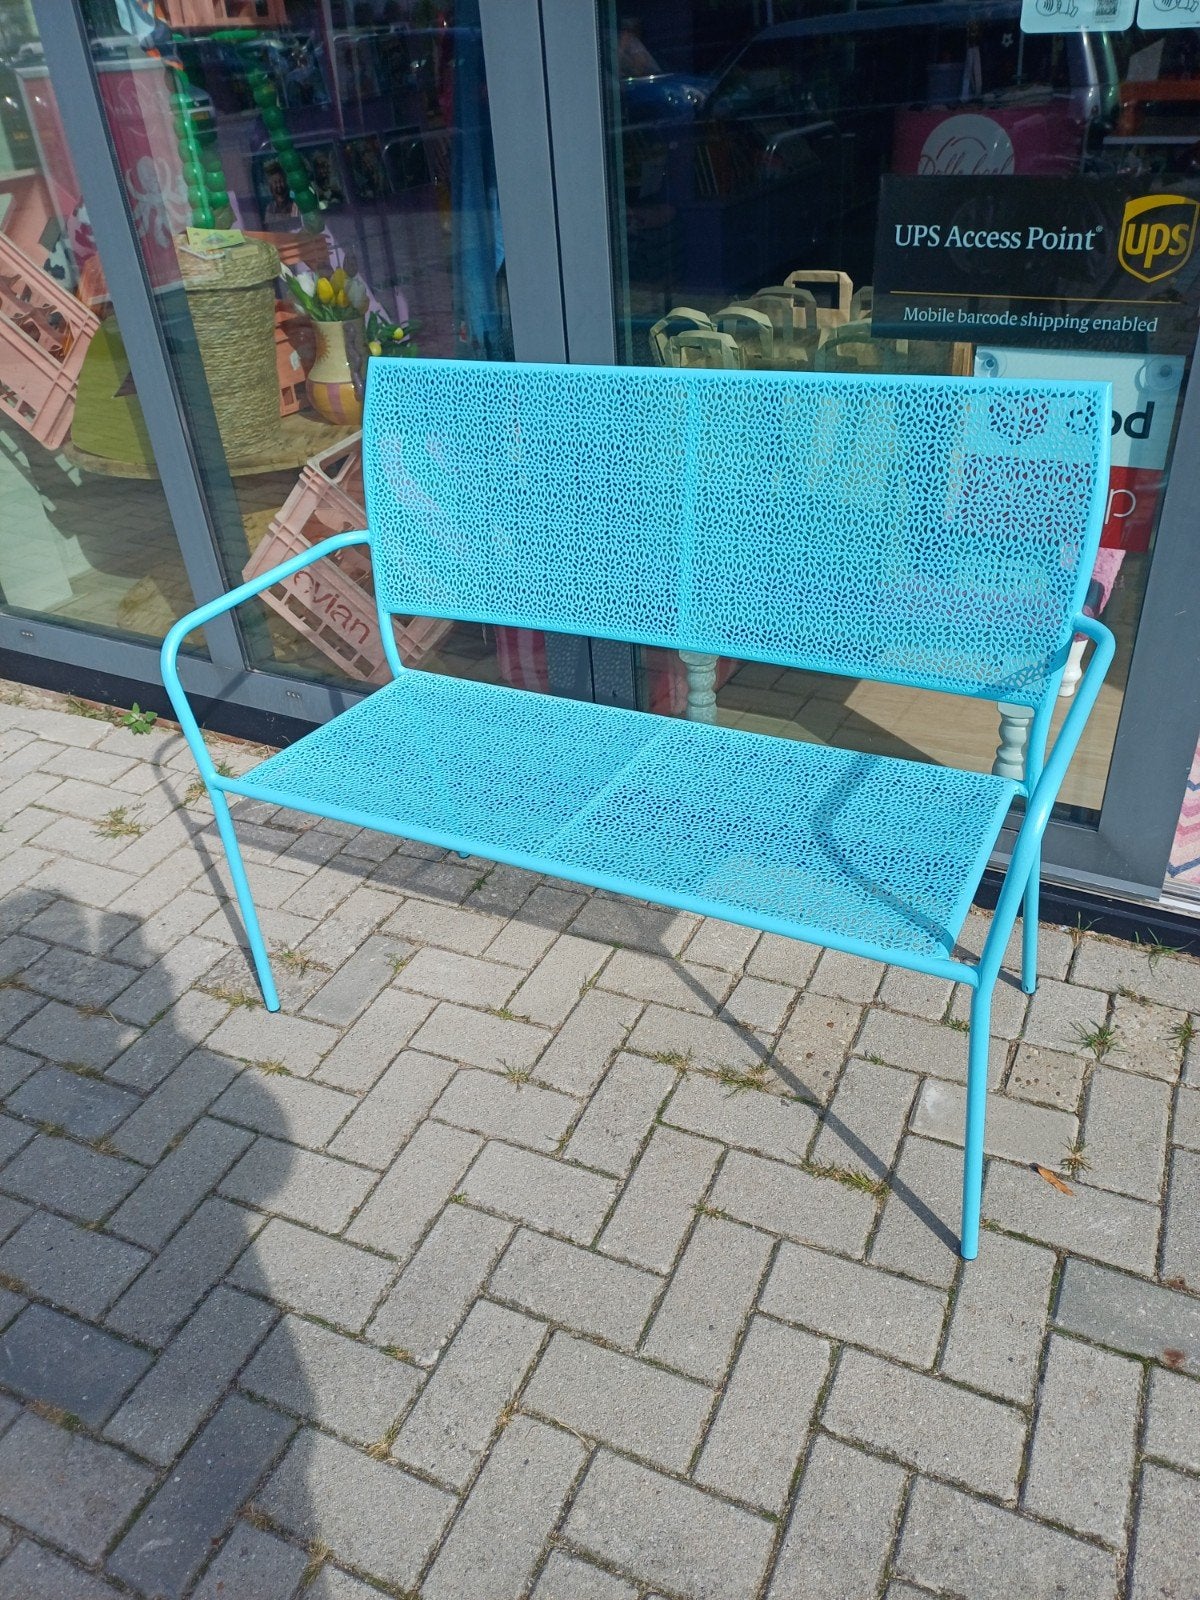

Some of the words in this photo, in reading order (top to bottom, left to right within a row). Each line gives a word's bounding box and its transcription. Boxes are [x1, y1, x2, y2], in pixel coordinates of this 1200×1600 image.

[895, 224, 941, 247] UPS
[944, 225, 1022, 249] Access
[903, 306, 955, 323] Mobile
[957, 308, 1018, 326] barcode
[1020, 312, 1090, 333] shipping
[1092, 316, 1159, 332] enabled
[293, 570, 371, 645] evian
